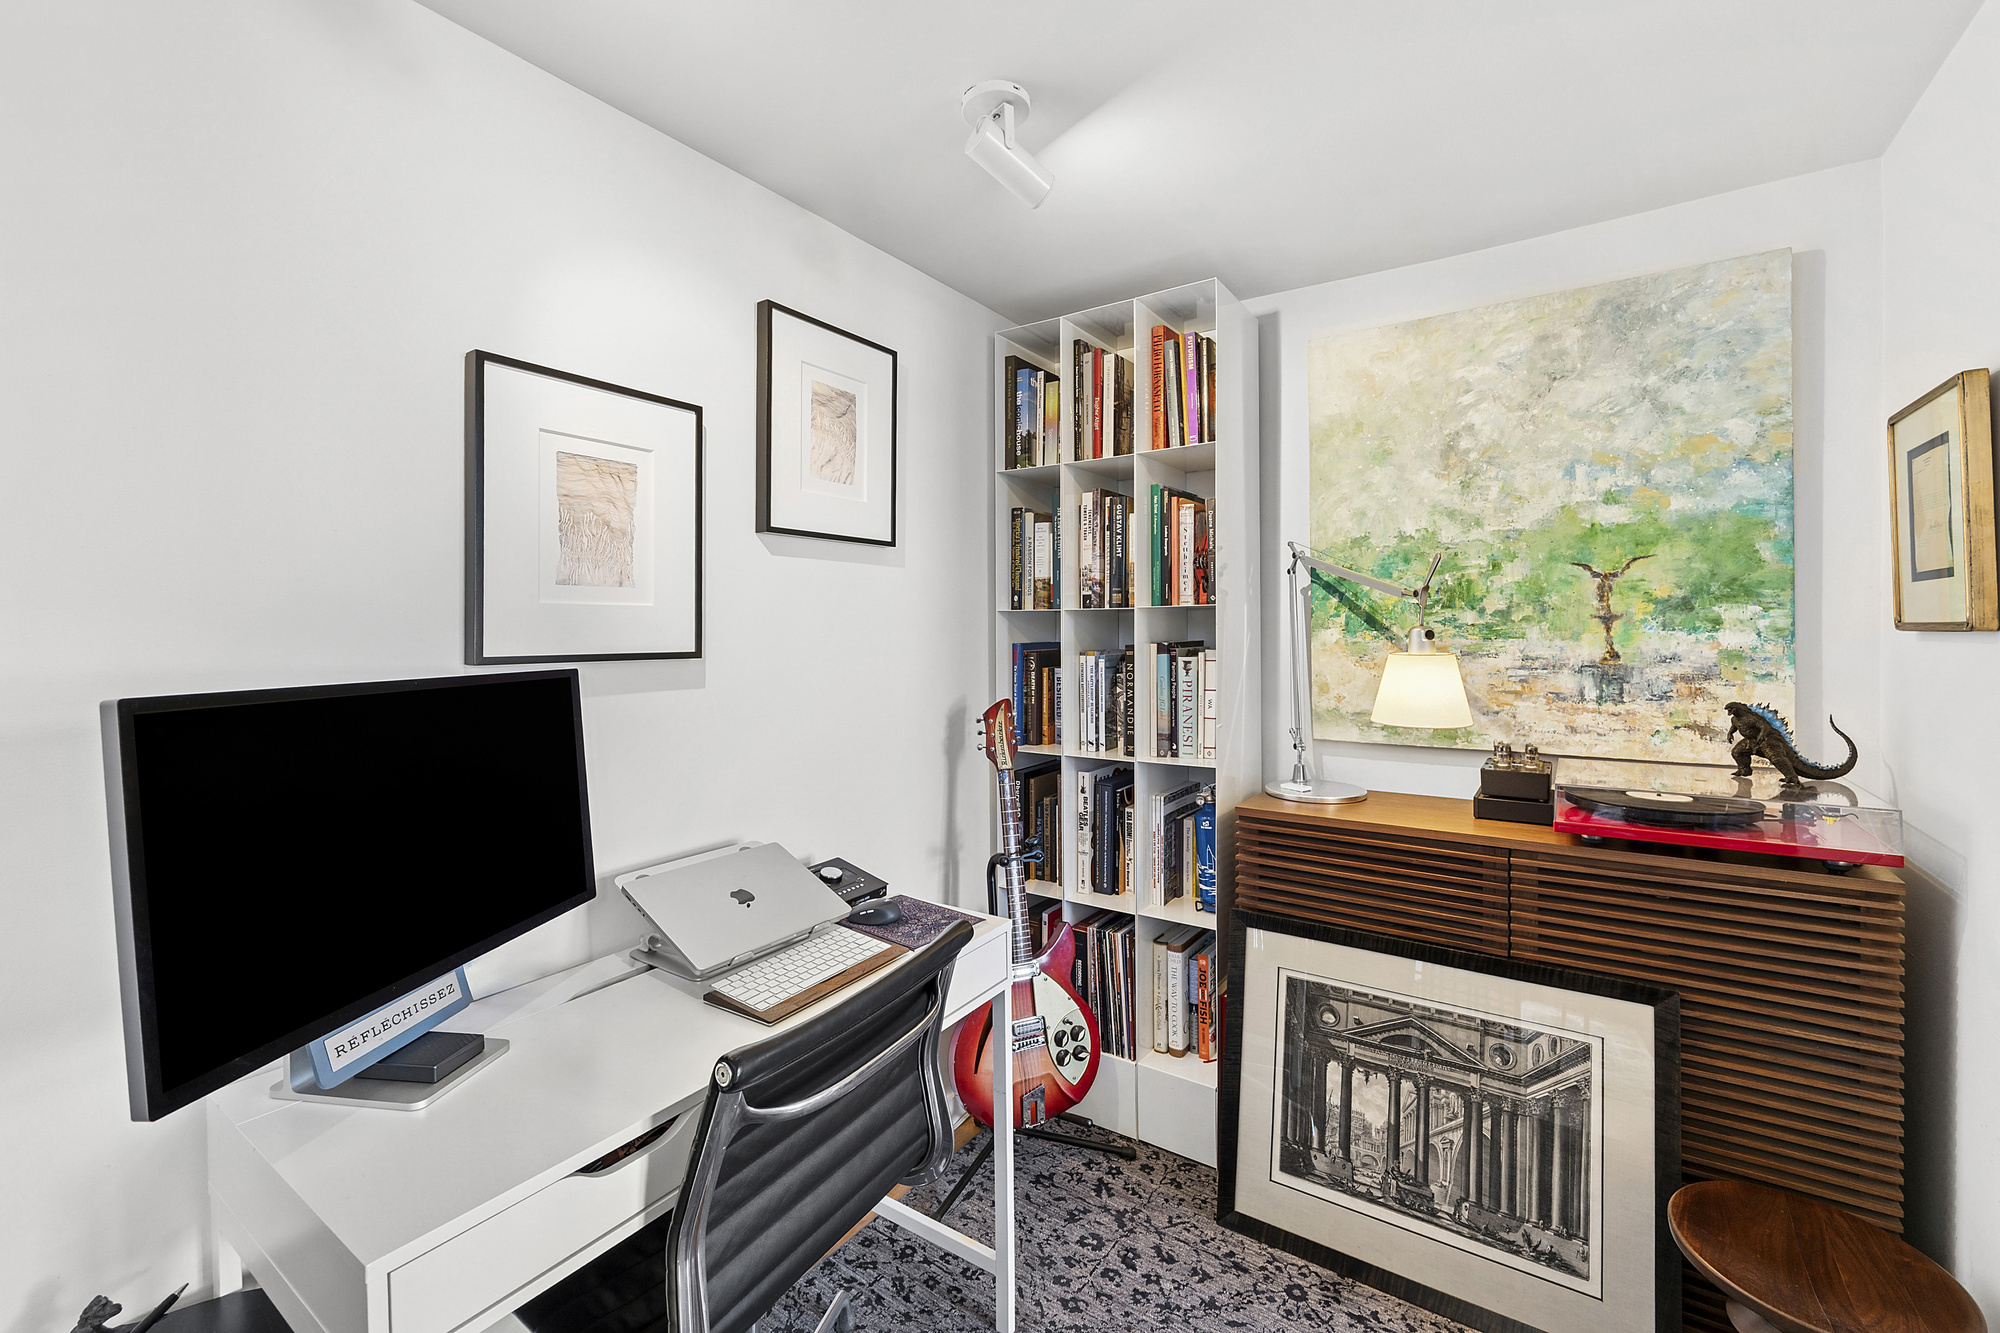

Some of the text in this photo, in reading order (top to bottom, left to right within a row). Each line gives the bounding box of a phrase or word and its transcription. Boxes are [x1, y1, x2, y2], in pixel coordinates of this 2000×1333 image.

[1154, 334, 1163, 361] PIERO
[1154, 362, 1163, 413] FORNASETTI
[1182, 680, 1193, 748] PIRANESI
[1208, 699, 1213, 709] WA
[997, 720, 1008, 766] Rickenbacker
[1045, 804, 1050, 812] Up
[1199, 968, 1207, 988] JOE
[1155, 1003, 1162, 1011] &
[1171, 1002, 1177, 1013] TO
[1199, 1000, 1207, 1025] FISH
[334, 983, 455, 1059] RÉFLÉCHISSEZ
